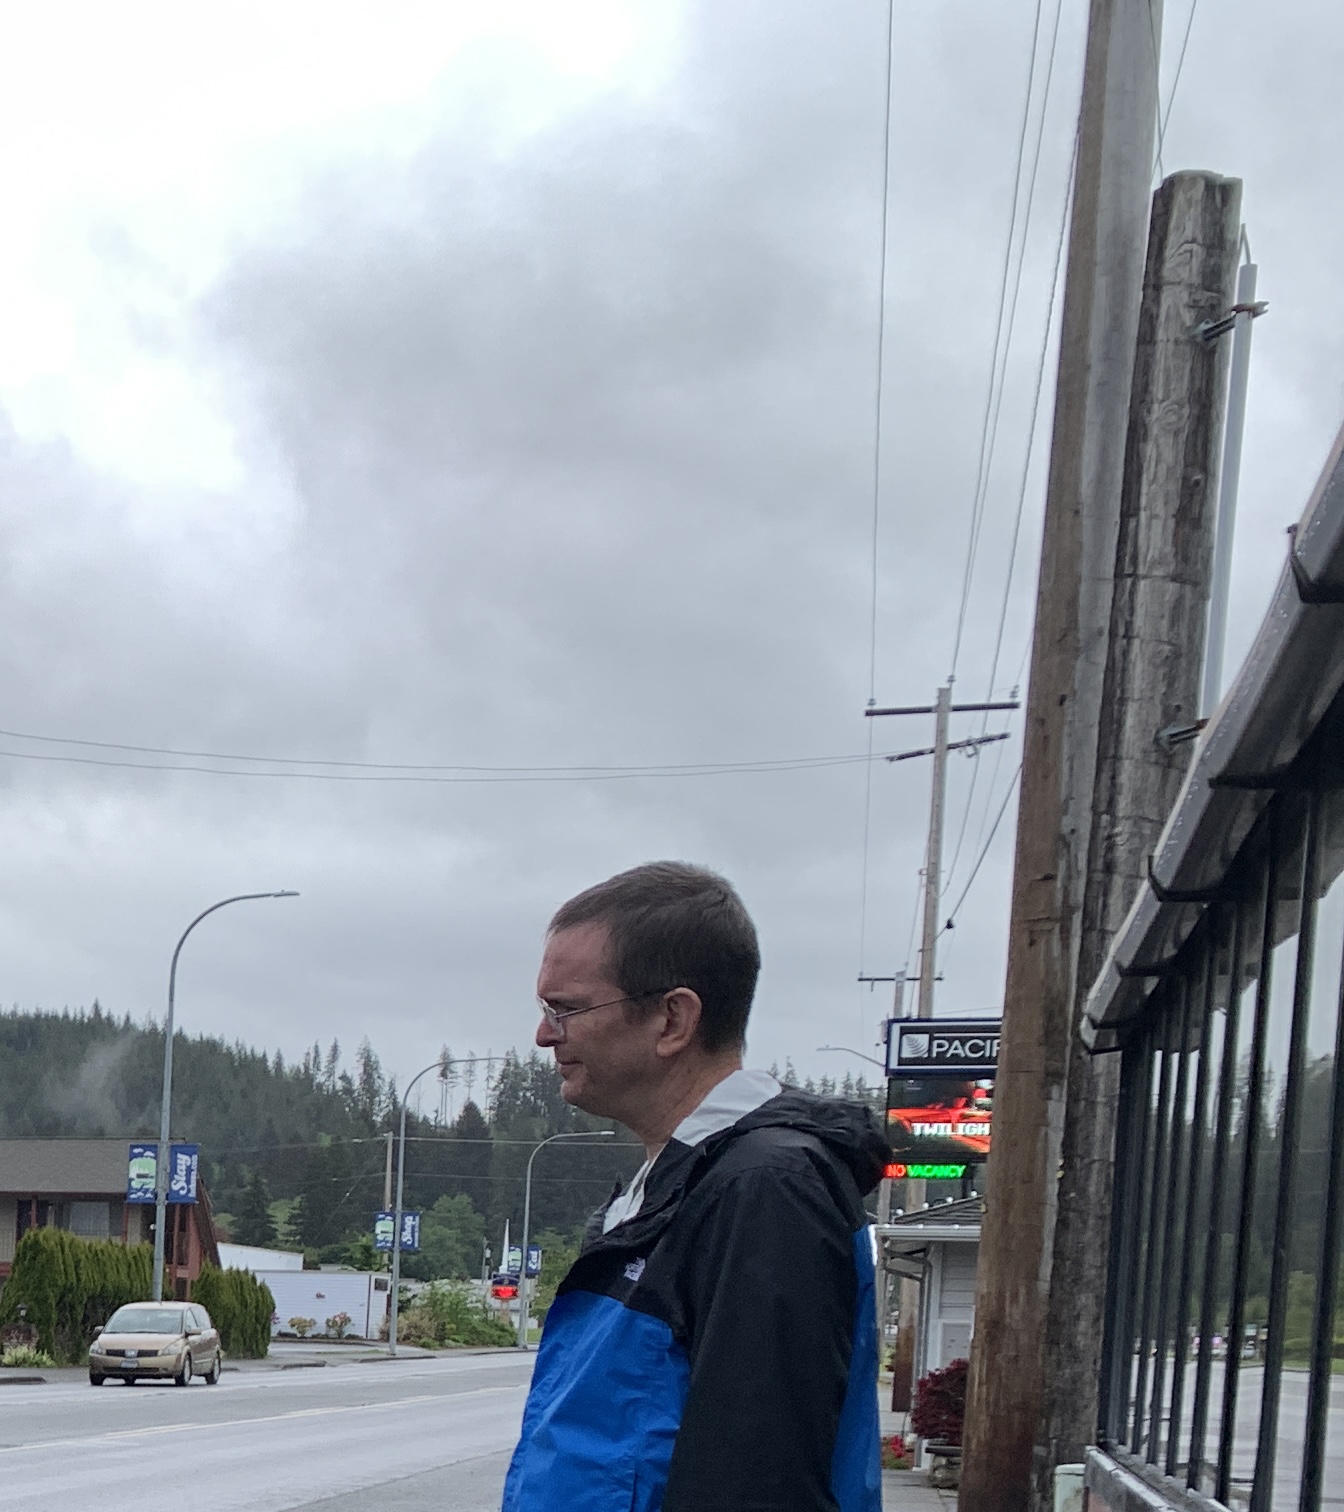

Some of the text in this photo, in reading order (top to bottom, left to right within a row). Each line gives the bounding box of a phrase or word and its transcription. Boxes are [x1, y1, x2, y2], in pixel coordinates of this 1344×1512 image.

[932, 1038, 1002, 1058] PACIF
[912, 1122, 991, 1136] TWILIGH
[171, 1152, 191, 1196] Stay
[886, 1164, 967, 1178] NO VACANCY
[402, 1215, 416, 1245] Shop
